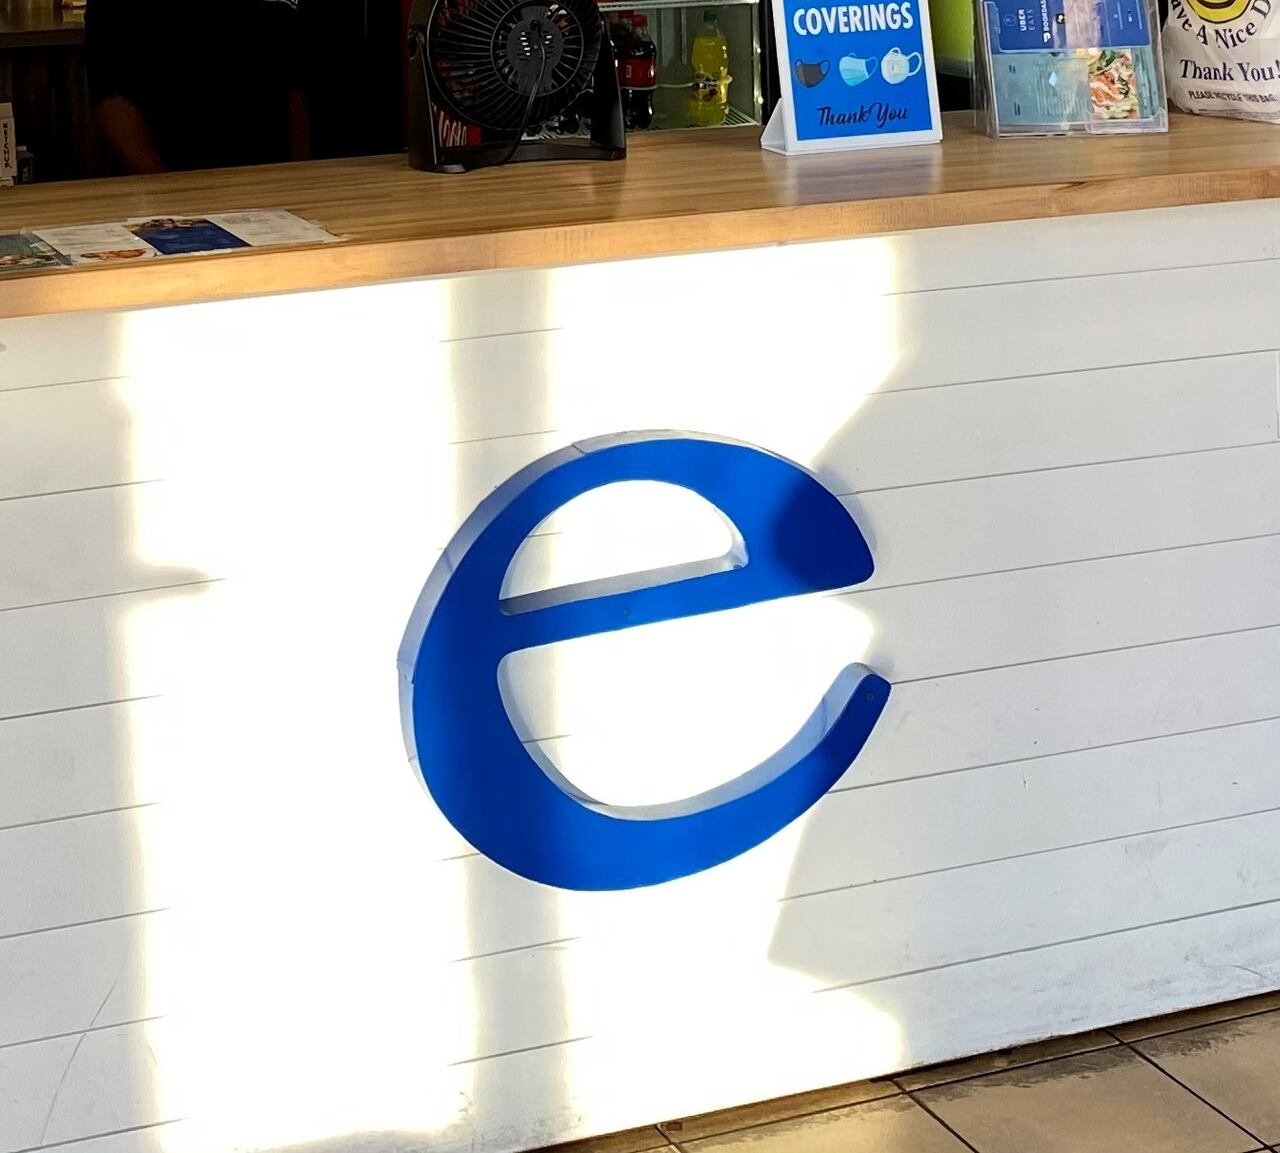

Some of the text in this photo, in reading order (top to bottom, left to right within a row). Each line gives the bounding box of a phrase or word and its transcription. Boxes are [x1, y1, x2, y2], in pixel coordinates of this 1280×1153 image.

[793, 1, 914, 35] COVERINGS
[1196, 24, 1209, 46] A
[1215, 20, 1257, 50] Nice
[1179, 59, 1234, 82] Thank
[1188, 90, 1213, 99] PLEASE
[817, 101, 909, 128] Thank You
